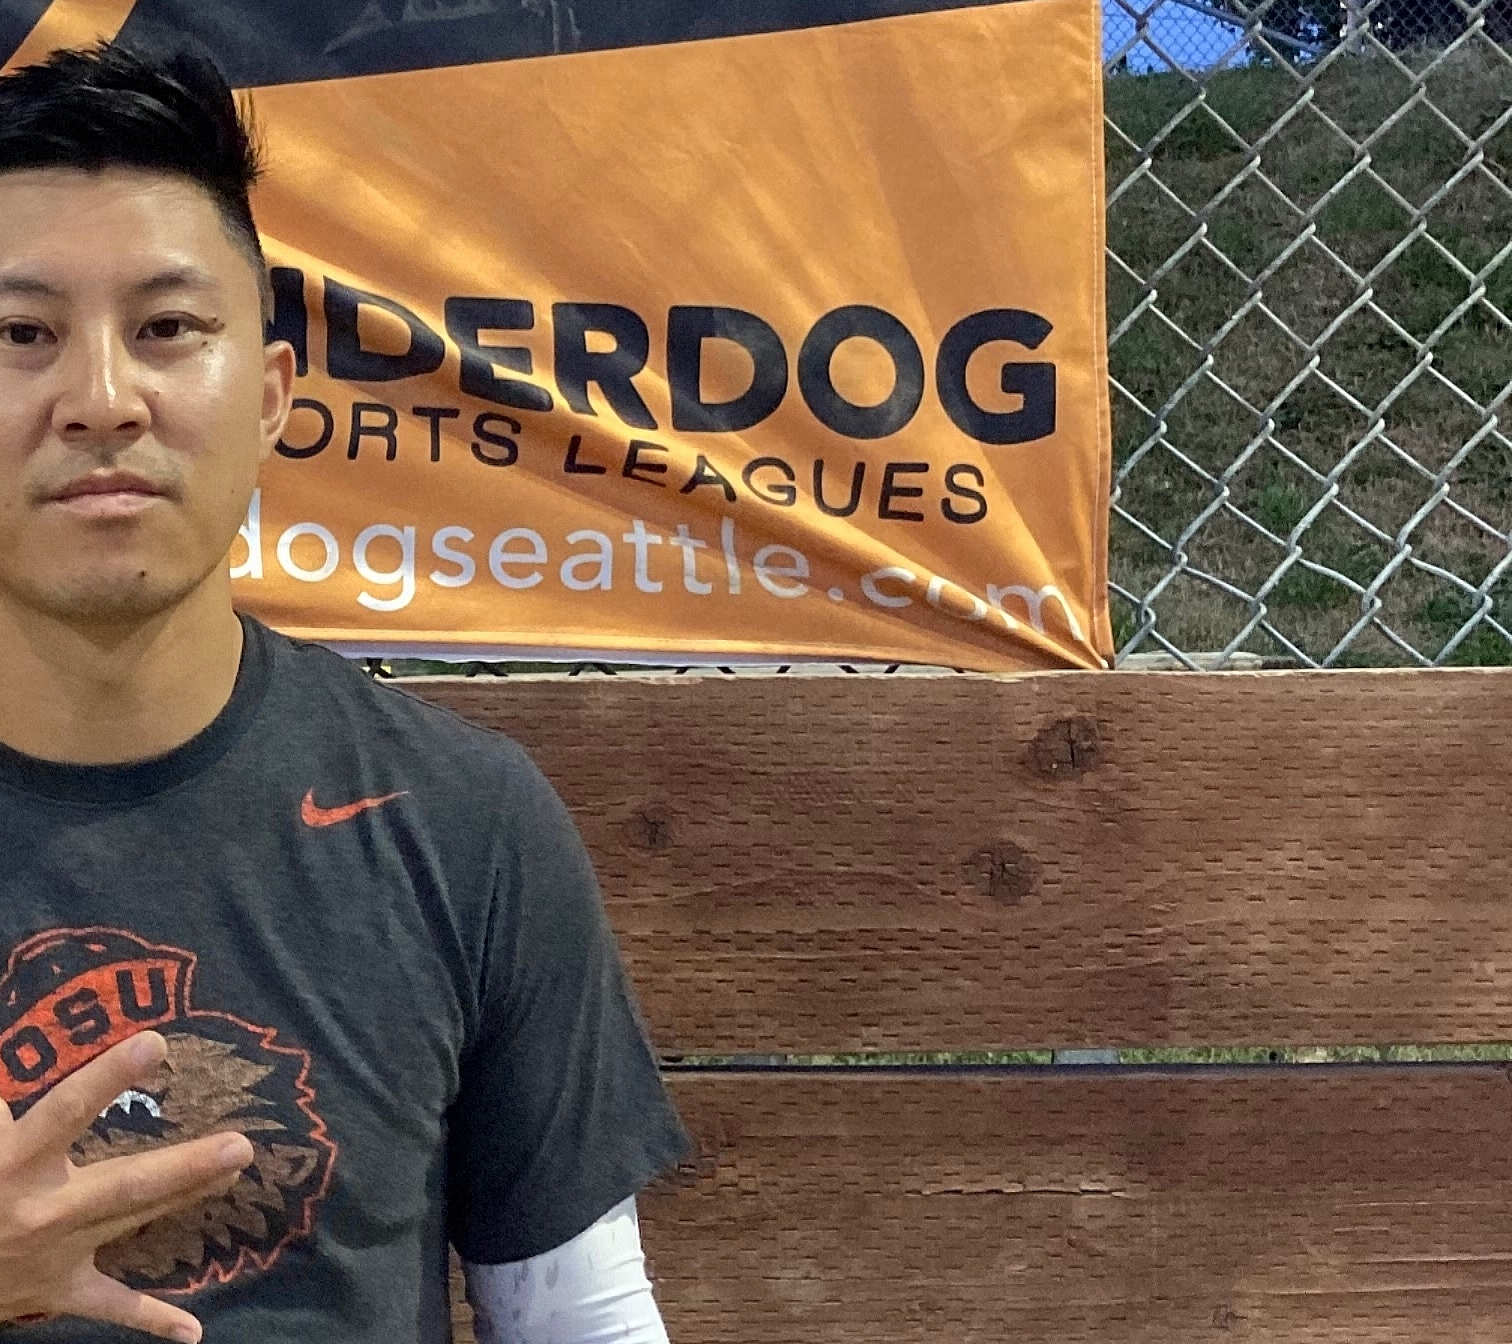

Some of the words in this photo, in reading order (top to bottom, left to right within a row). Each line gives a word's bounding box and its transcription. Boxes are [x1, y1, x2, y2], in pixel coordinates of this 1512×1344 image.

[265, 266, 1057, 445] DERDOG
[274, 398, 523, 468] ORTS
[564, 434, 988, 524] LEAGUES
[0, 967, 170, 1082] OSU
